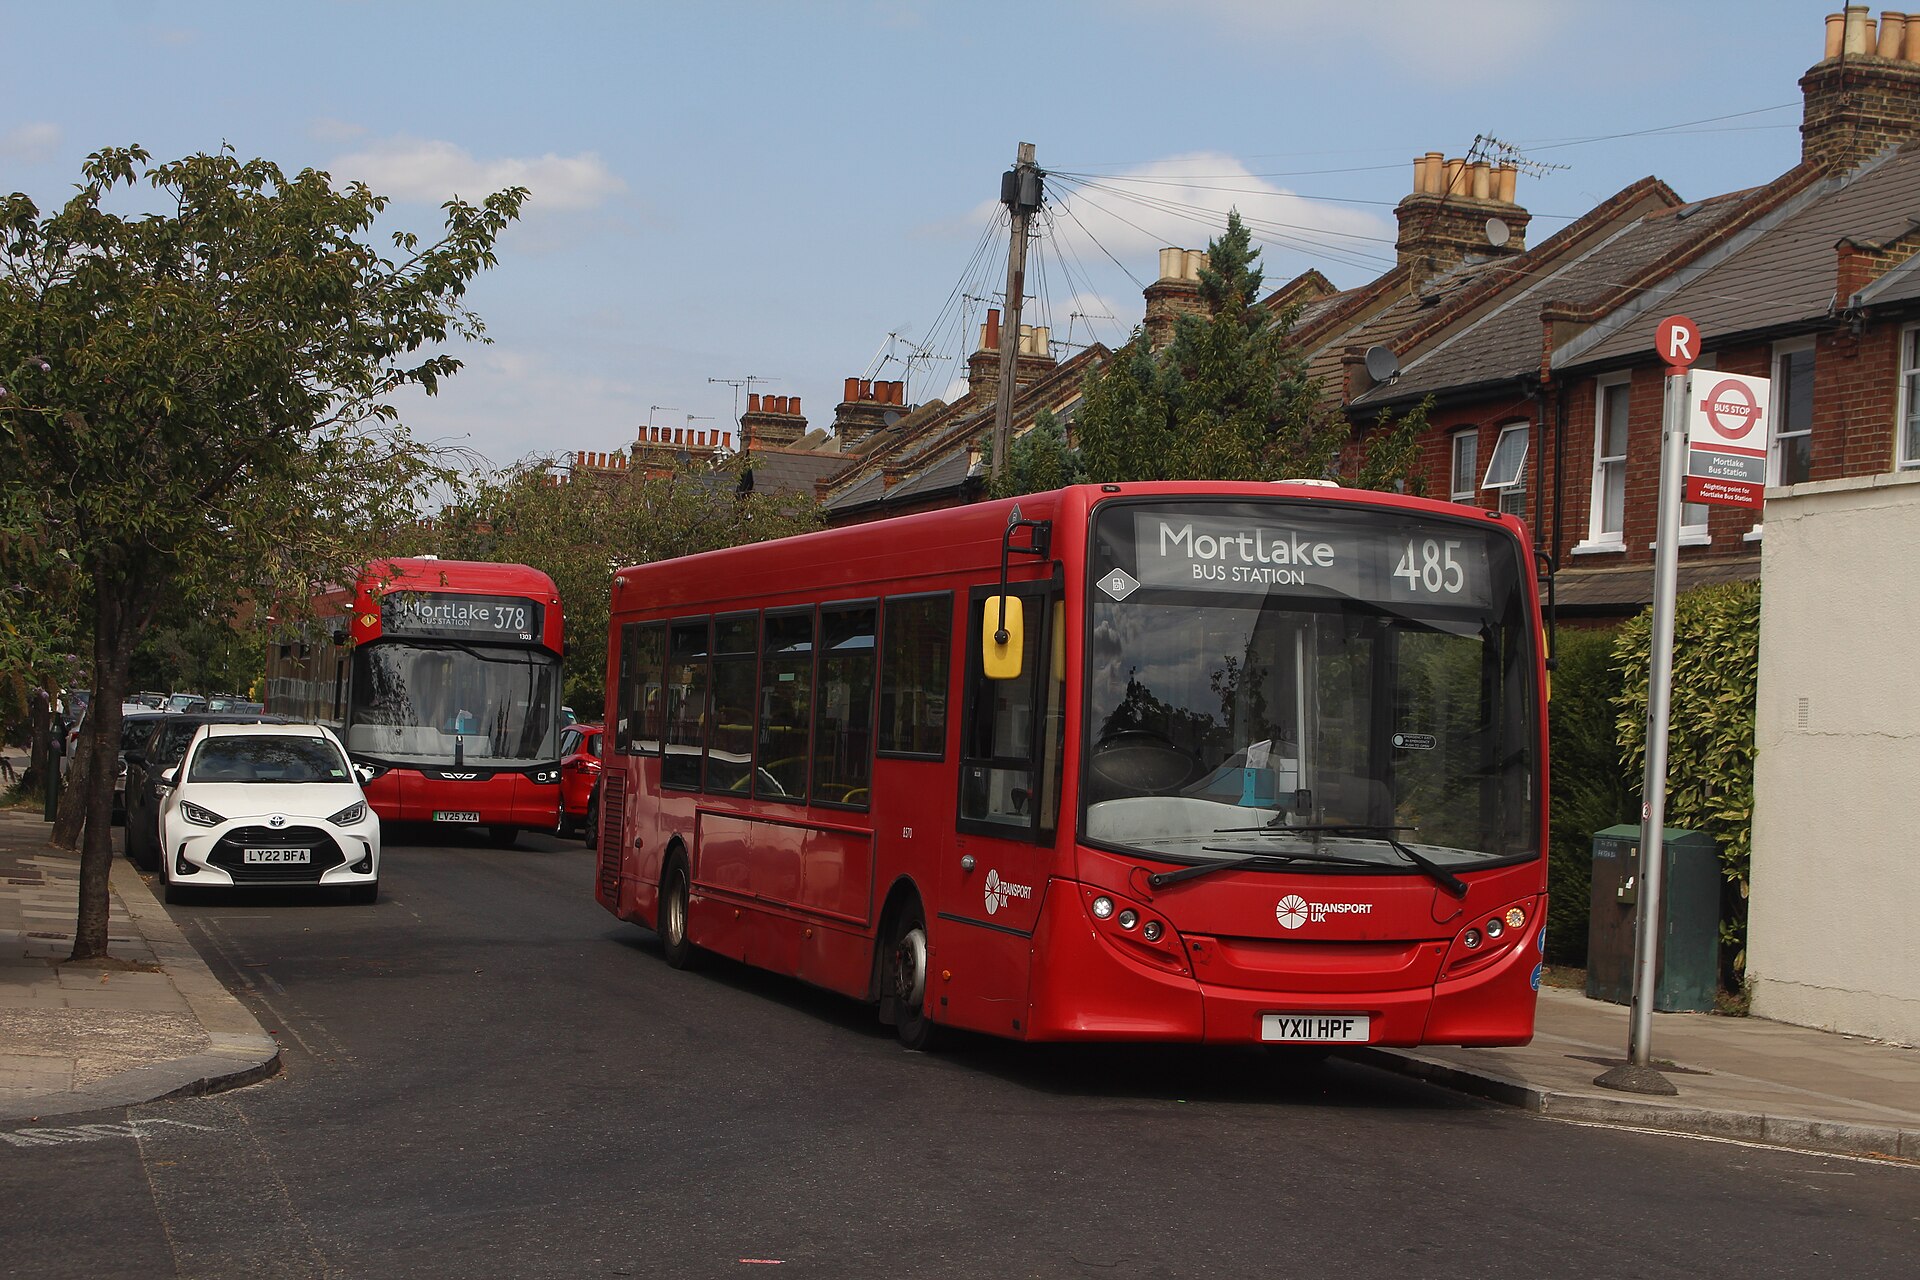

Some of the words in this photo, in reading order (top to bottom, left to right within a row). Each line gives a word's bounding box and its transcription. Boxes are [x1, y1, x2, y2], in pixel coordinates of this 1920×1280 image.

[1670, 325, 1692, 360] R
[1714, 403, 1730, 413] BUS
[1731, 405, 1751, 416] STOP
[1713, 457, 1744, 468] Mortlake
[1708, 465, 1721, 475] Bus
[1722, 467, 1748, 477] Station
[1703, 483, 1727, 493] Alighting
[1700, 490, 1724, 499] Mortlake
[1734, 494, 1753, 503] Station
[1159, 522, 1335, 567] Mortlake
[1393, 538, 1465, 594] 485
[1192, 564, 1227, 582] BUS
[1231, 565, 1305, 586] STATION
[403, 600, 490, 620] Mortlake
[494, 606, 525, 630] 378
[421, 617, 437, 626] BUS
[438, 618, 471, 627] STATION
[437, 812, 460, 822] LV25
[461, 812, 479, 822] XZA
[249, 850, 280, 862] LY22
[283, 850, 306, 862] BFA
[1000, 881, 1032, 900] TRANSPORT
[1000, 894, 1009, 908] UK
[1309, 902, 1373, 914] TRANSPORT
[1310, 912, 1326, 923] UK
[1278, 1018, 1313, 1038] YX11
[1317, 1019, 1355, 1038] HPF
